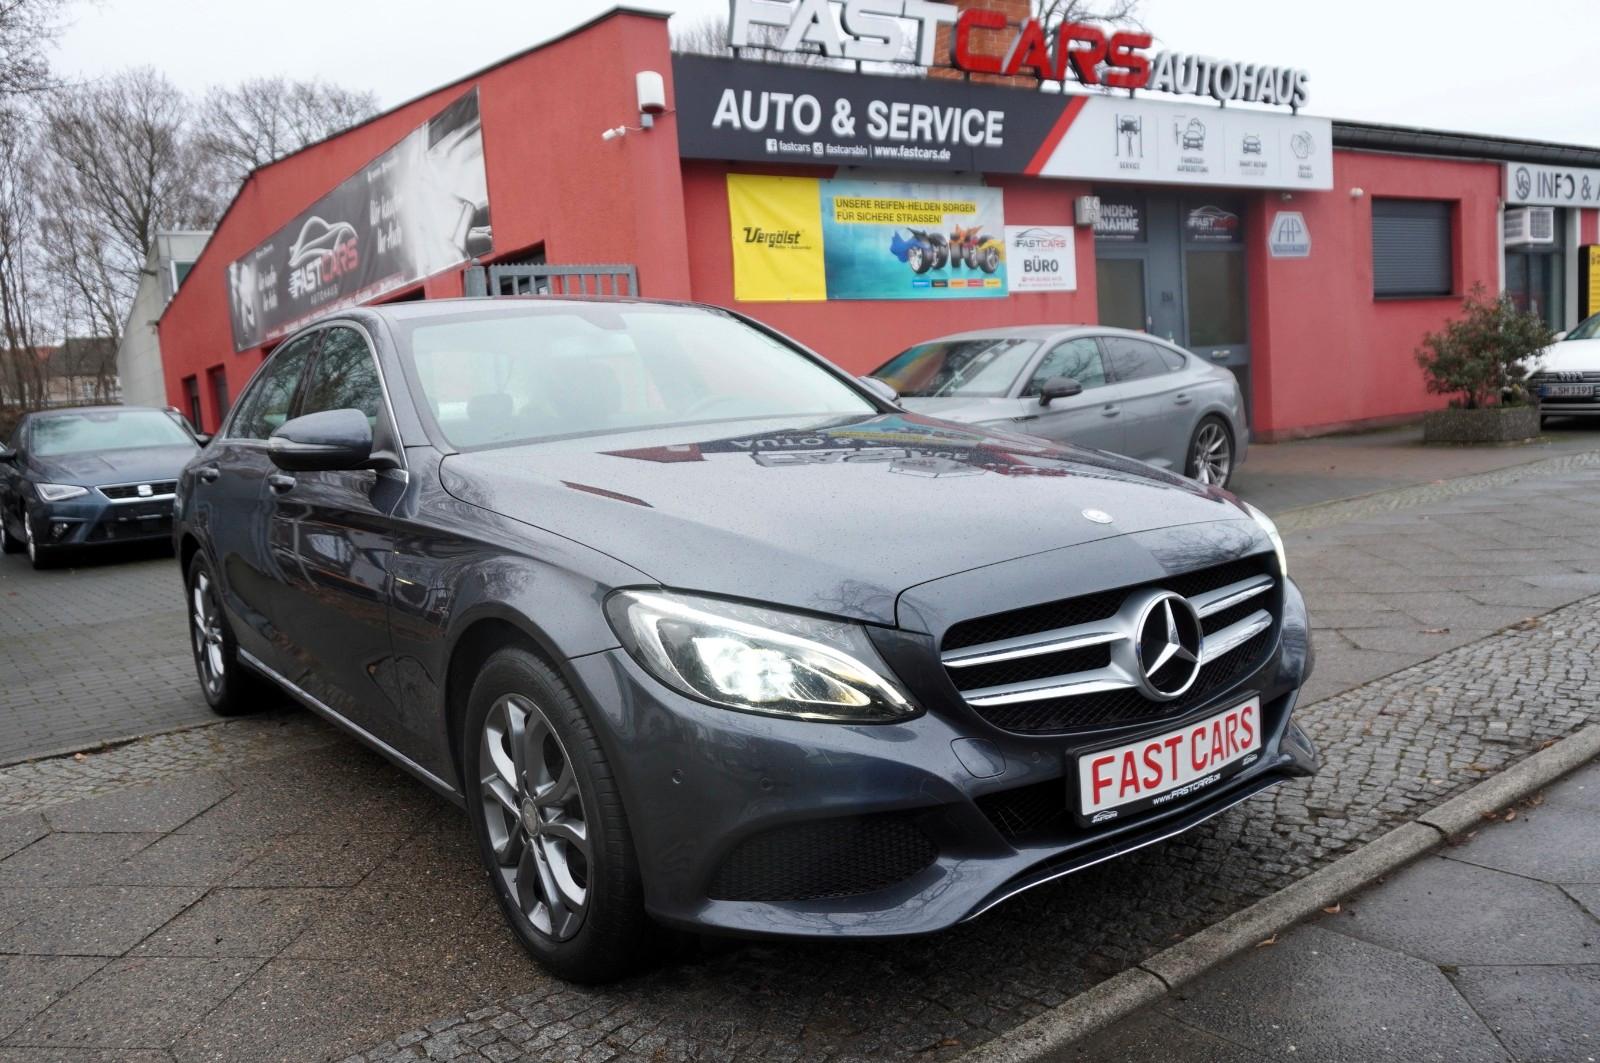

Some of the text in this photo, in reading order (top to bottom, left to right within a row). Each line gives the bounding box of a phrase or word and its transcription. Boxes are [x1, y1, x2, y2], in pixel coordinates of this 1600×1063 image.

[1147, 50, 1311, 108] AUTOHAUS
[712, 88, 1005, 145] AUTO & SERVICE
[779, 140, 811, 153] fastcars
[875, 144, 951, 160] www.fastcars.de
[1580, 174, 1592, 201] &
[836, 199, 976, 213] UNSERE REIFEN-HELDEN SORGEN
[1099, 203, 1138, 217] UNDEN-
[836, 210, 942, 224] FÜR SICHERE STRASSEN!
[743, 226, 801, 248] Vergölst
[1014, 239, 1067, 248] FASTCARS
[288, 237, 359, 299] FASTCARS
[1023, 255, 1059, 273] BÜRO
[1091, 705, 1253, 805] FAST CARS
